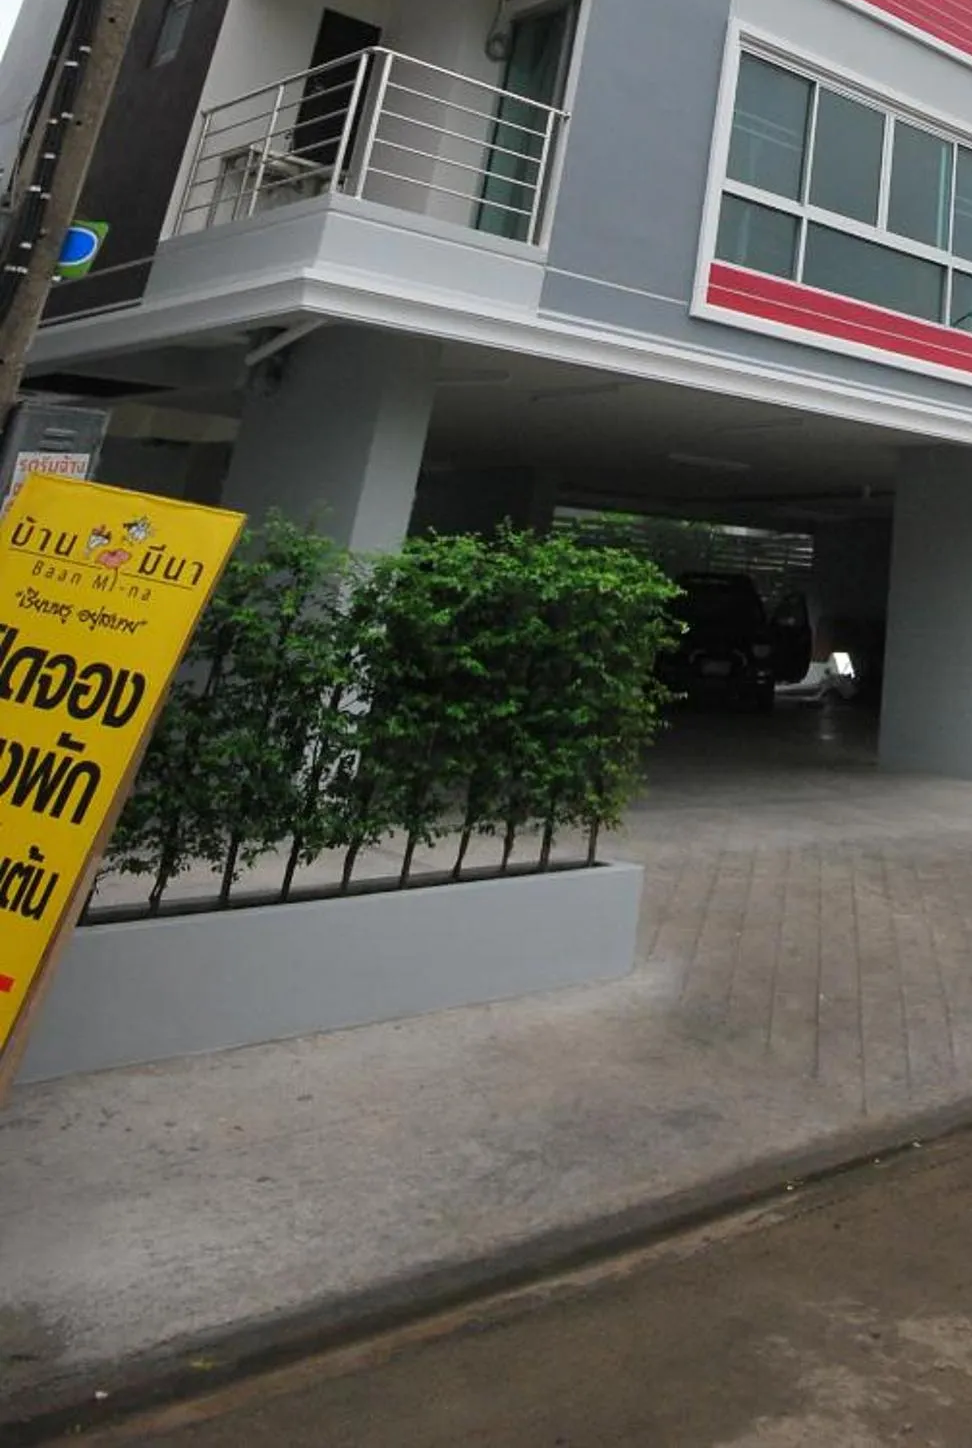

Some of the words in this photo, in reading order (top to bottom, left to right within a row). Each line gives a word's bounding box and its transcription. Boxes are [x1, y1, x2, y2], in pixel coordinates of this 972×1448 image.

[10, 515, 79, 557] บ้าน
[138, 544, 204, 586] มีนา
[31, 560, 83, 586] Baan
